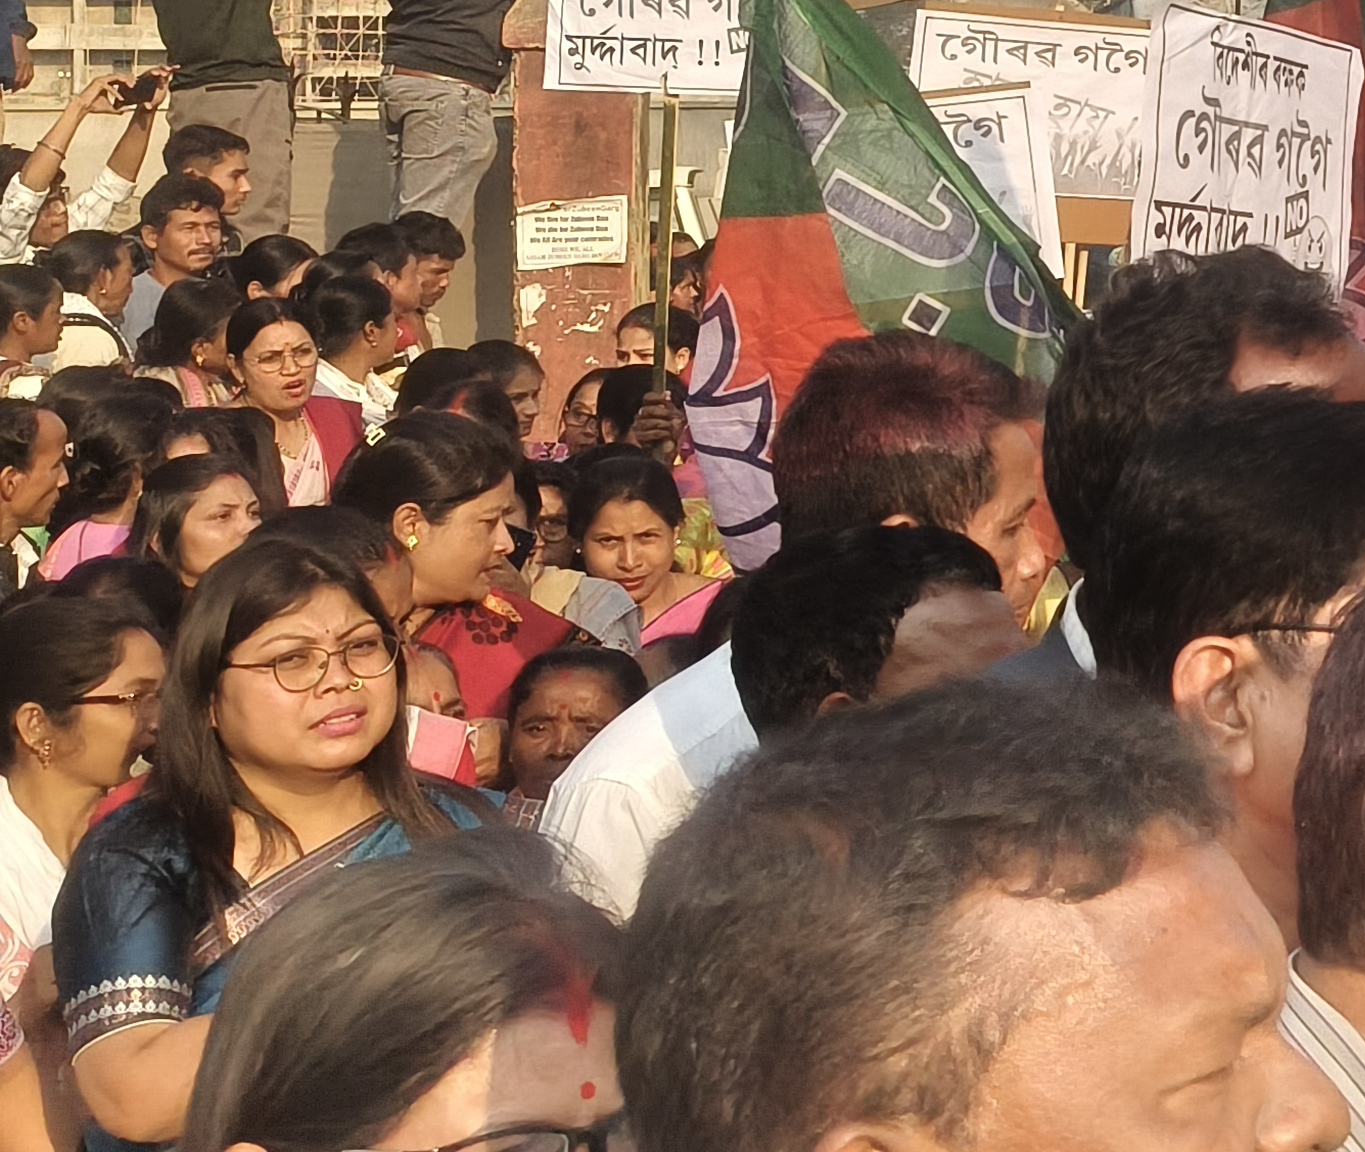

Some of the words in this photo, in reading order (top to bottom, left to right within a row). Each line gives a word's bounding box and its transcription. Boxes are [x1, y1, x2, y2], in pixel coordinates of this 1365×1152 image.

[698, 39, 721, 67] !!
[936, 25, 1062, 68] গৌৰৱ
[1074, 38, 1149, 75] গগৈ
[940, 110, 1009, 148] গৈ
[1175, 85, 1269, 181] গৌৰৱ
[1276, 109, 1332, 192] গগৈ
[1287, 198, 1307, 234] NO
